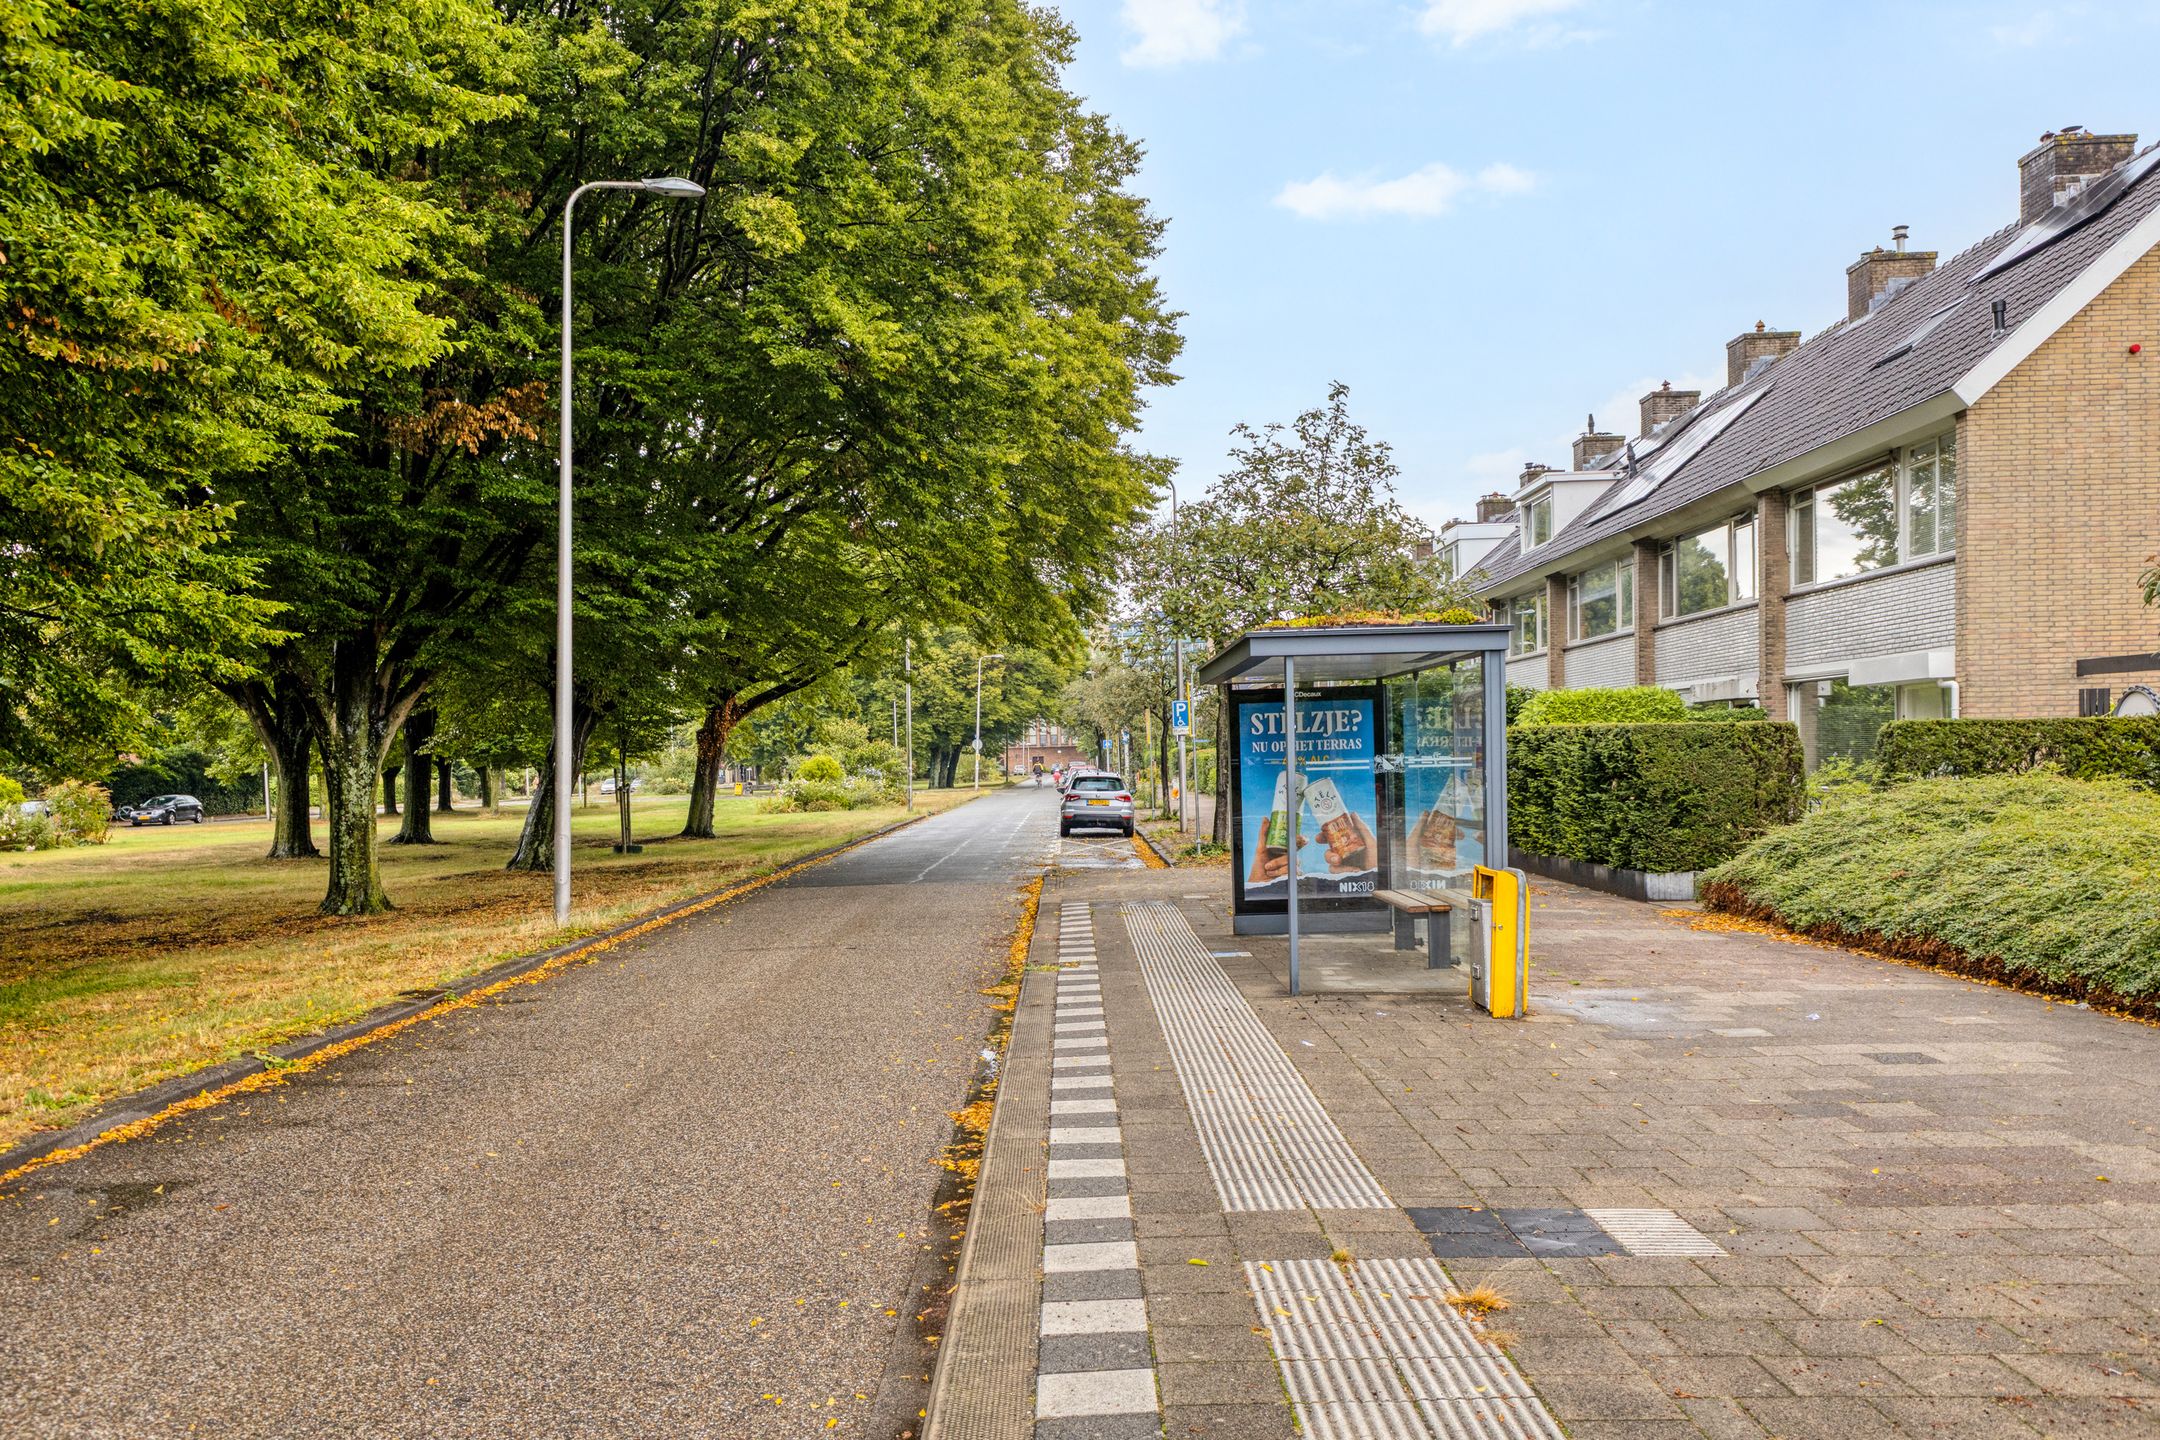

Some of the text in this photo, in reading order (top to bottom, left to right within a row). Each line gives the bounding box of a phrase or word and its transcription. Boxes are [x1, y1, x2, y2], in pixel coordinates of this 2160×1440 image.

[1176, 703, 1187, 717] P
[1252, 741, 1268, 753] NU
[1316, 738, 1363, 750] TERRAS
[1340, 881, 1375, 893] NIX18
